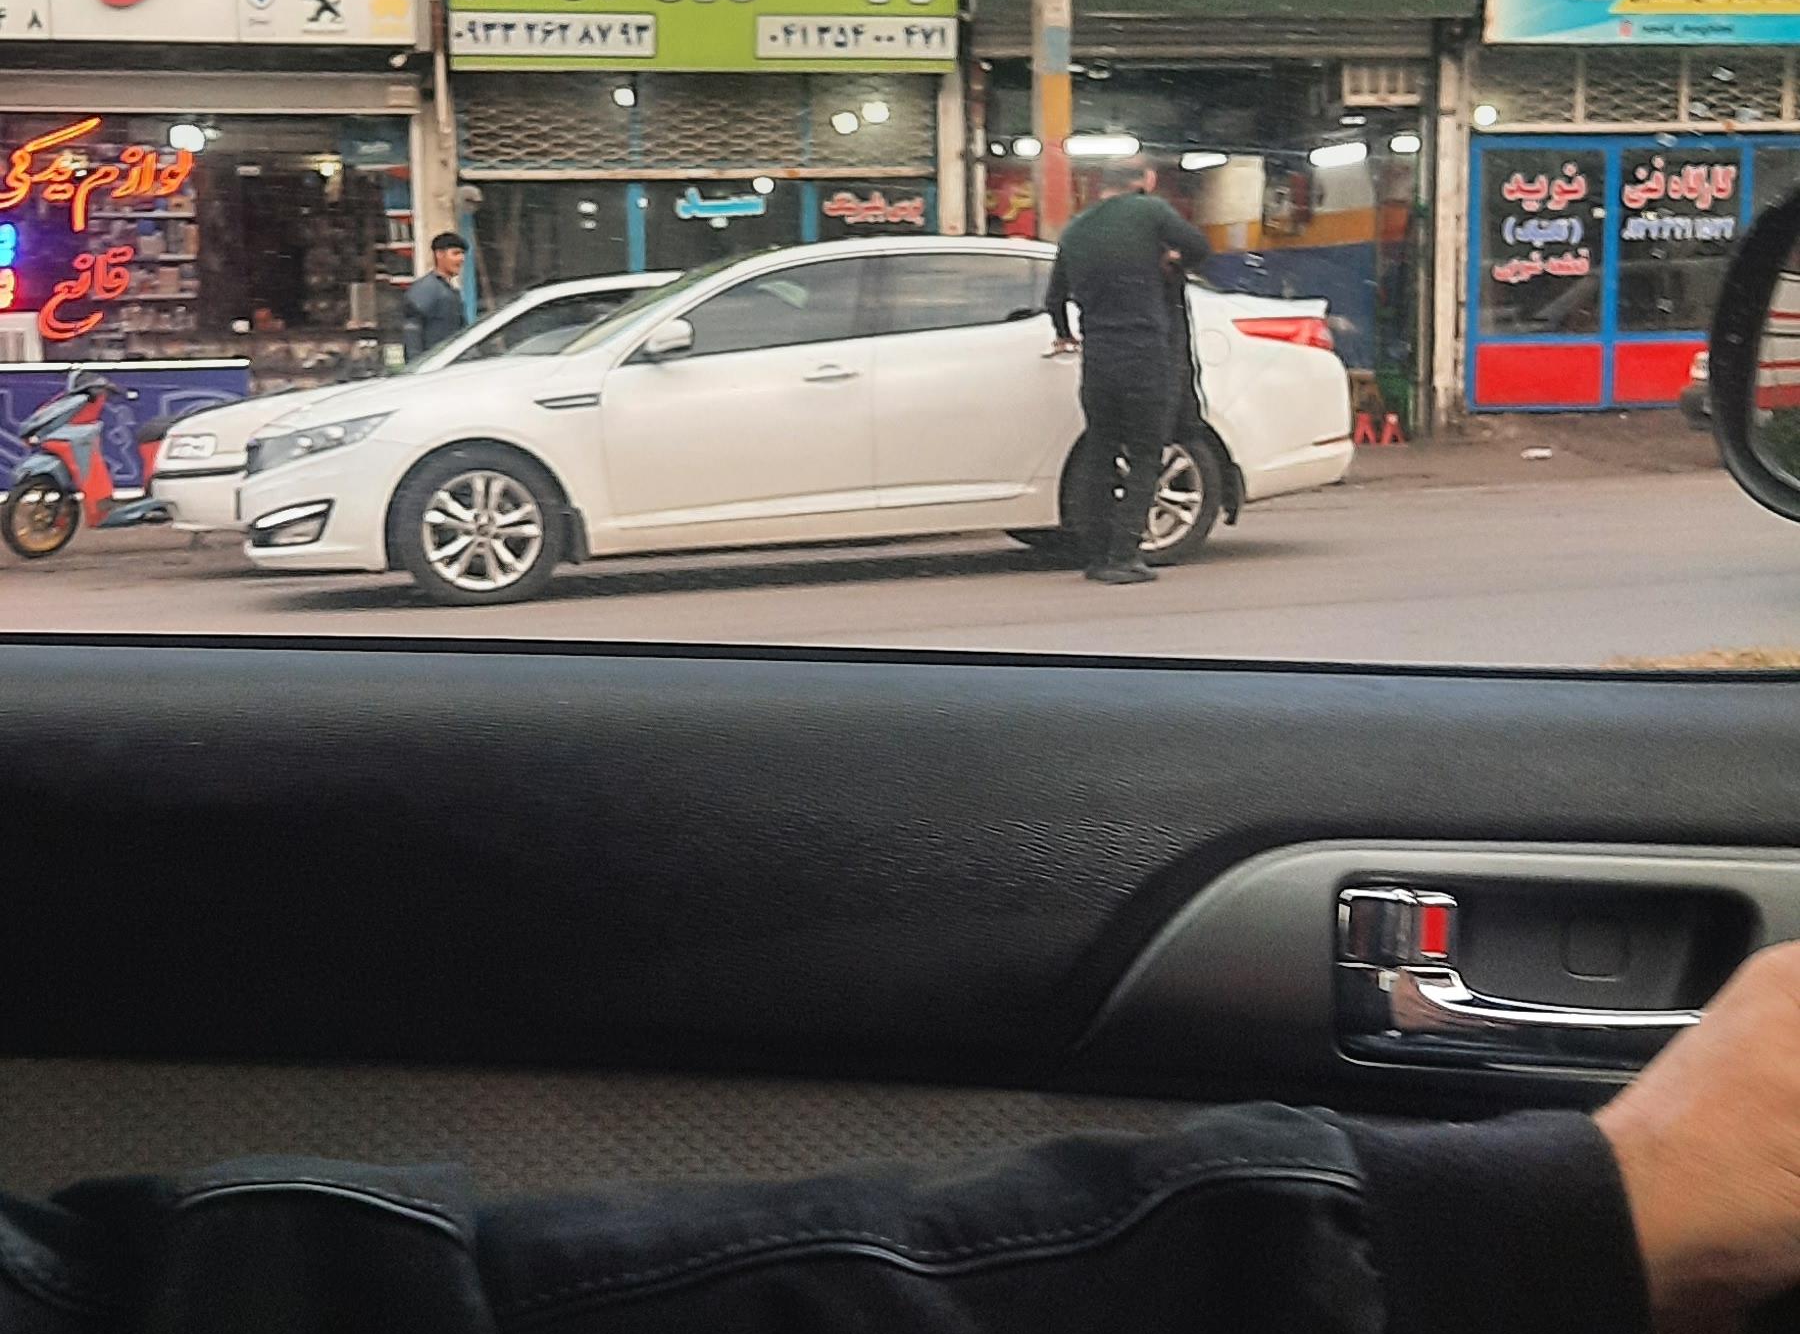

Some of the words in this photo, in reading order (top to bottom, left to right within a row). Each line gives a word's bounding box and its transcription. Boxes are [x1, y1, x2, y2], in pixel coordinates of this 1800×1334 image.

[72, 146, 194, 233] لوازم
[1502, 162, 1587, 211] نوید
[39, 244, 134, 341] قانع
